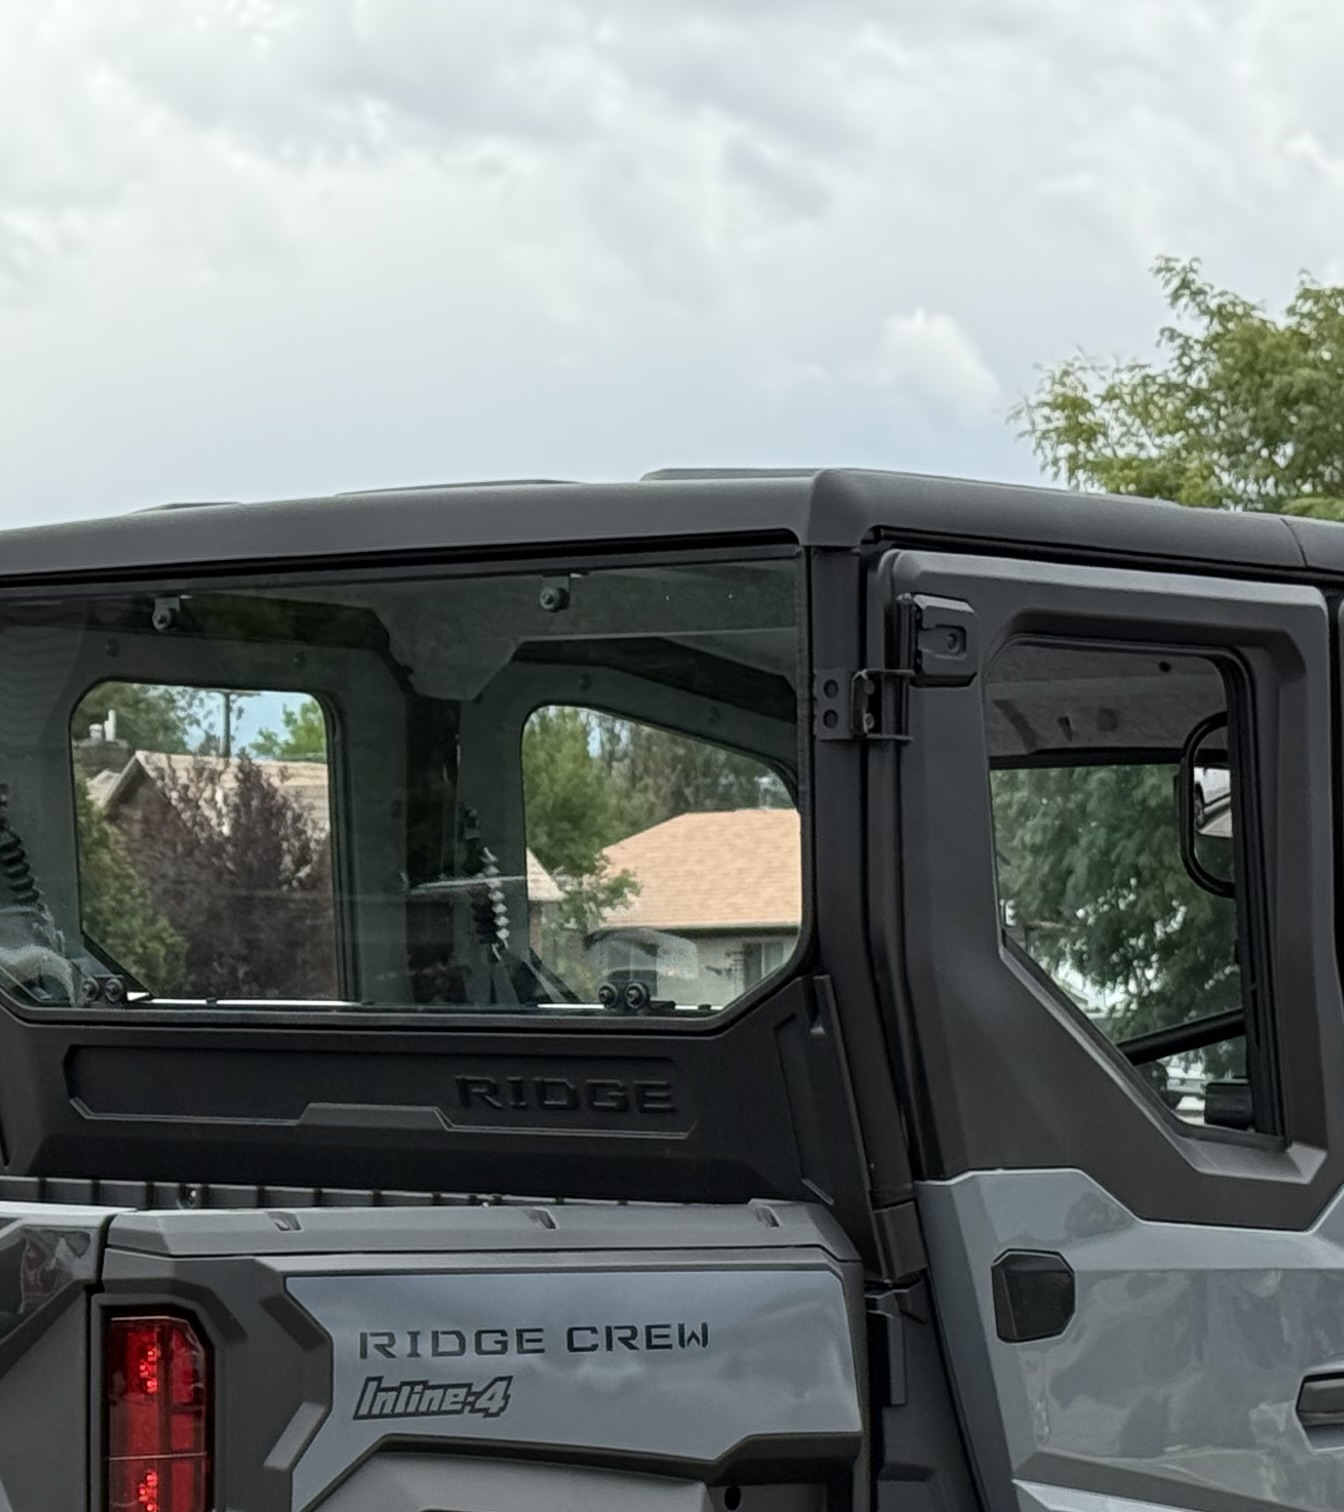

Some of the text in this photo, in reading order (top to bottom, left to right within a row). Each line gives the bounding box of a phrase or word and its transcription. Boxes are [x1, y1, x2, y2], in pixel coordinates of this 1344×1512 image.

[455, 1075, 676, 1114] RIDGE
[359, 1322, 709, 1360] RIDGE CREW
[354, 1376, 513, 1422] Inline-4
